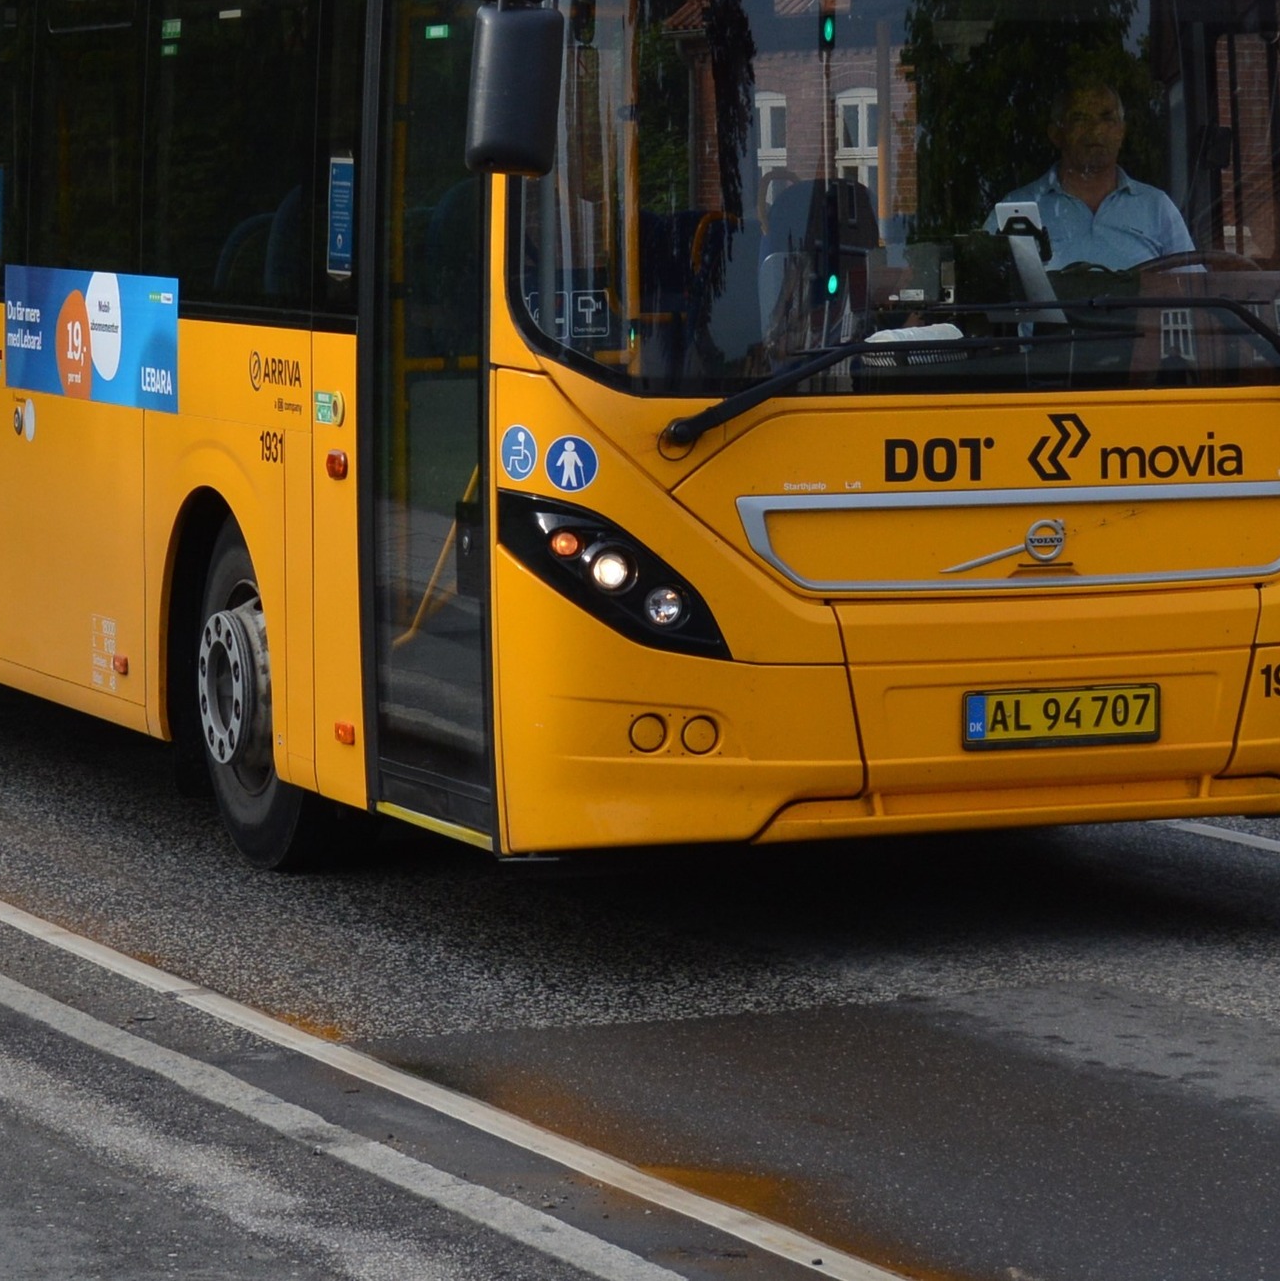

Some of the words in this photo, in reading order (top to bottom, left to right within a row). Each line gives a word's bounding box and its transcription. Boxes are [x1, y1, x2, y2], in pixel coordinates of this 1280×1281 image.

[7, 300, 16, 320] Du
[25, 306, 41, 323] mere
[7, 328, 21, 348] med
[21, 328, 42, 350] Lebara!
[141, 366, 173, 395] LEBARA
[263, 357, 302, 388] ARRIVA
[260, 430, 283, 464] 1931
[884, 437, 994, 482] DOT
[1100, 431, 1244, 480] movia
[969, 722, 983, 733] DK
[989, 699, 1032, 732] AL
[1042, 696, 1082, 731] 94
[1091, 693, 1151, 728] 707
